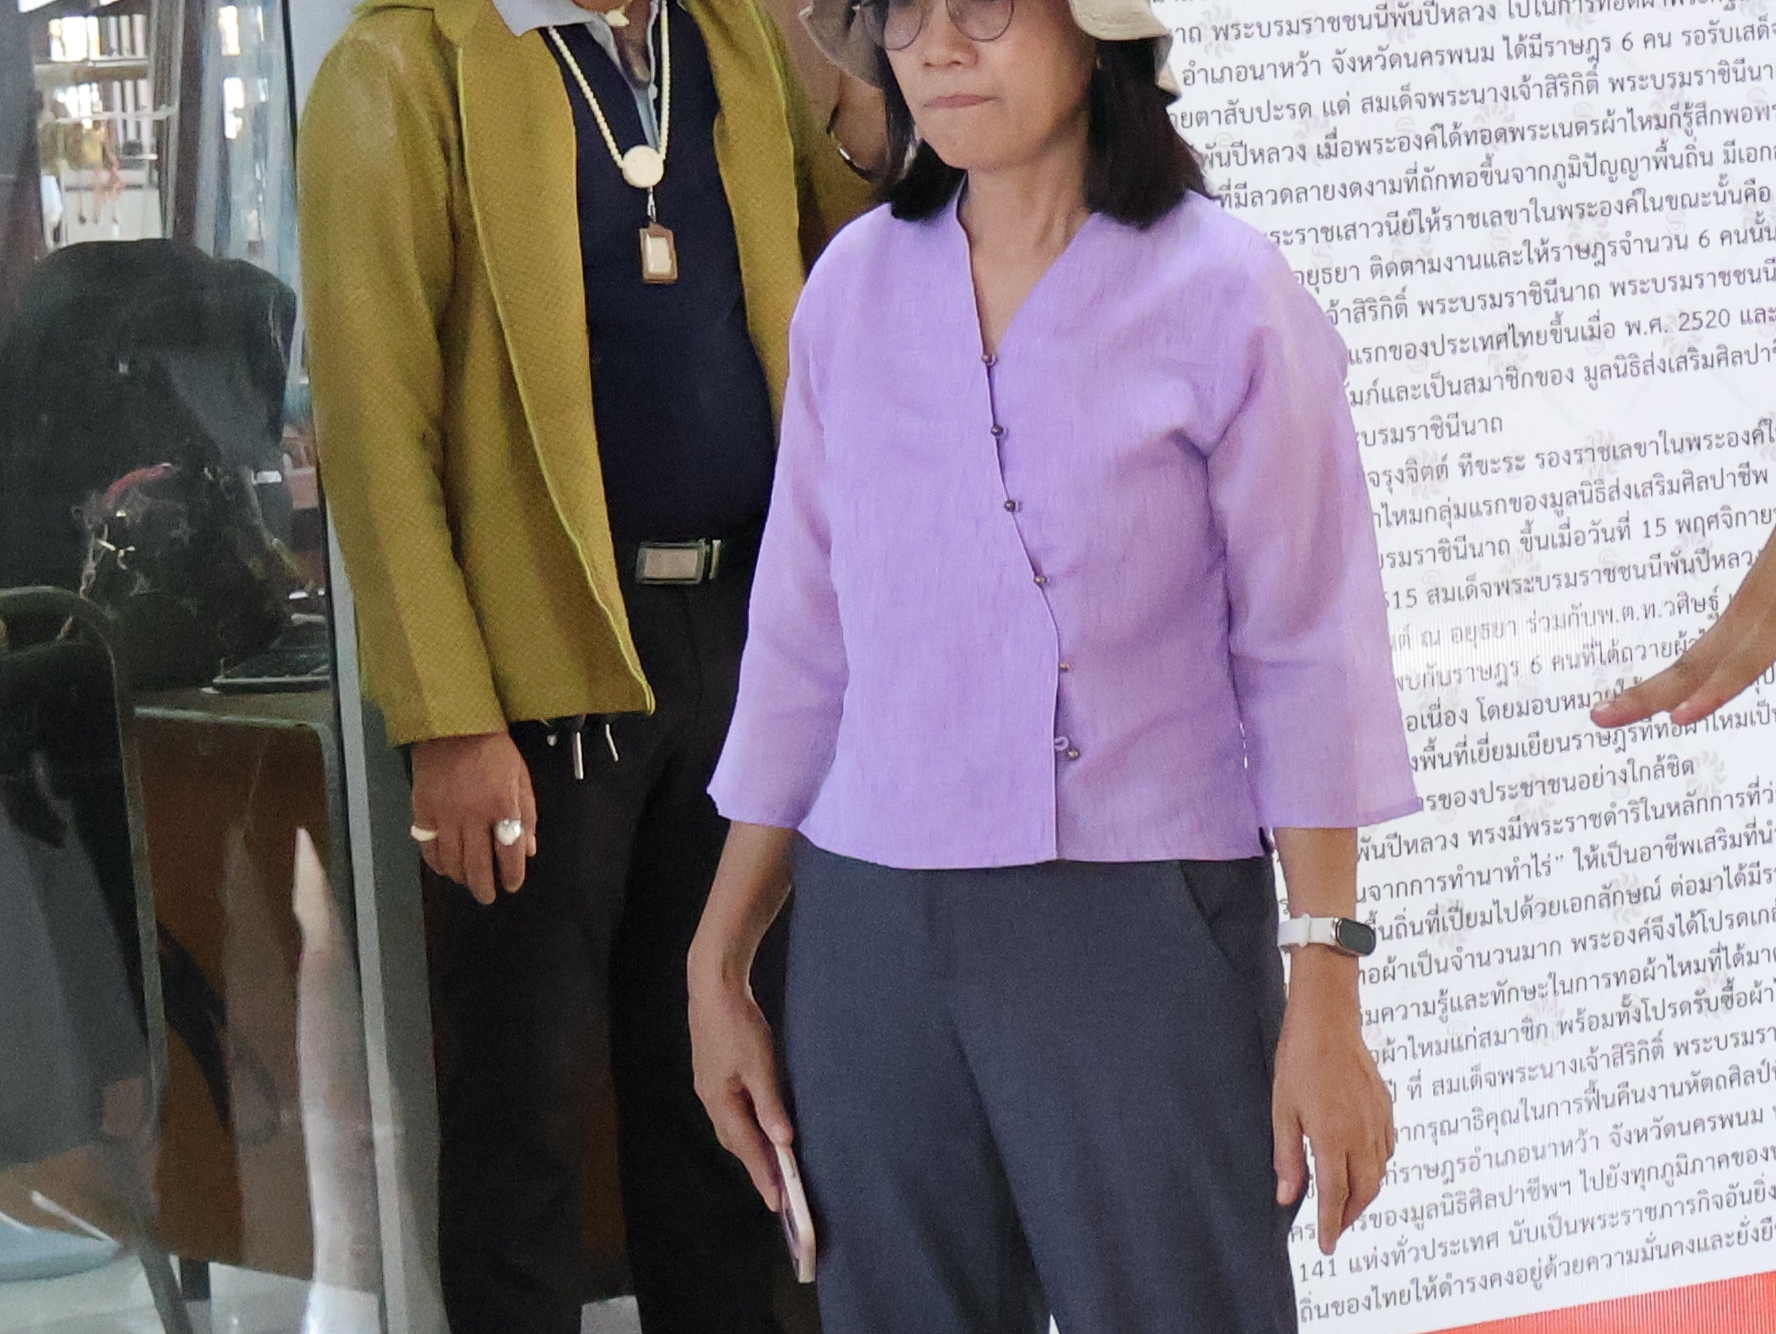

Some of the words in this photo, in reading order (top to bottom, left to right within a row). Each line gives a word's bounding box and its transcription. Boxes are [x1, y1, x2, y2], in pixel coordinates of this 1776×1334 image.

[1181, 49, 1321, 86] อำเภอนาหว้า
[1330, 43, 1495, 75] จังหวัดนครพนม
[1501, 31, 1611, 70] ได้มีราษฎร
[1620, 30, 1634, 52] 6
[1642, 31, 1672, 49] คน
[1321, 90, 1351, 118] แด่
[1360, 52, 1599, 114] สมเด็จพระนางเจ้าสิริกิติ์
[1369, 229, 1689, 293] ติดตามงานและให้ราษฎรจำนวน
[1697, 228, 1711, 249] 6
[1416, 276, 1600, 317] พระบรมราชินีนาถ
[1623, 316, 1668, 337] พ.ศ.
[1677, 307, 1731, 332] 2520
[1518, 508, 1631, 553] ขึ้นเมื่อวันที่
[1642, 516, 1667, 539] 15
[1425, 546, 1753, 605] สมเด็จพระบรมราชชนนีพันปีหลว
[1529, 653, 1543, 675] 6
[1405, 1067, 1422, 1101] ที่
[1431, 1028, 1665, 1097] สมเด็จพระนางเจ้าสิริกิติ์
[1608, 1106, 1764, 1148] จังหวัดนครพนม
[1299, 1257, 1336, 1283] 141
[1348, 1222, 1499, 1274] แห่งทั่วประเทศ
